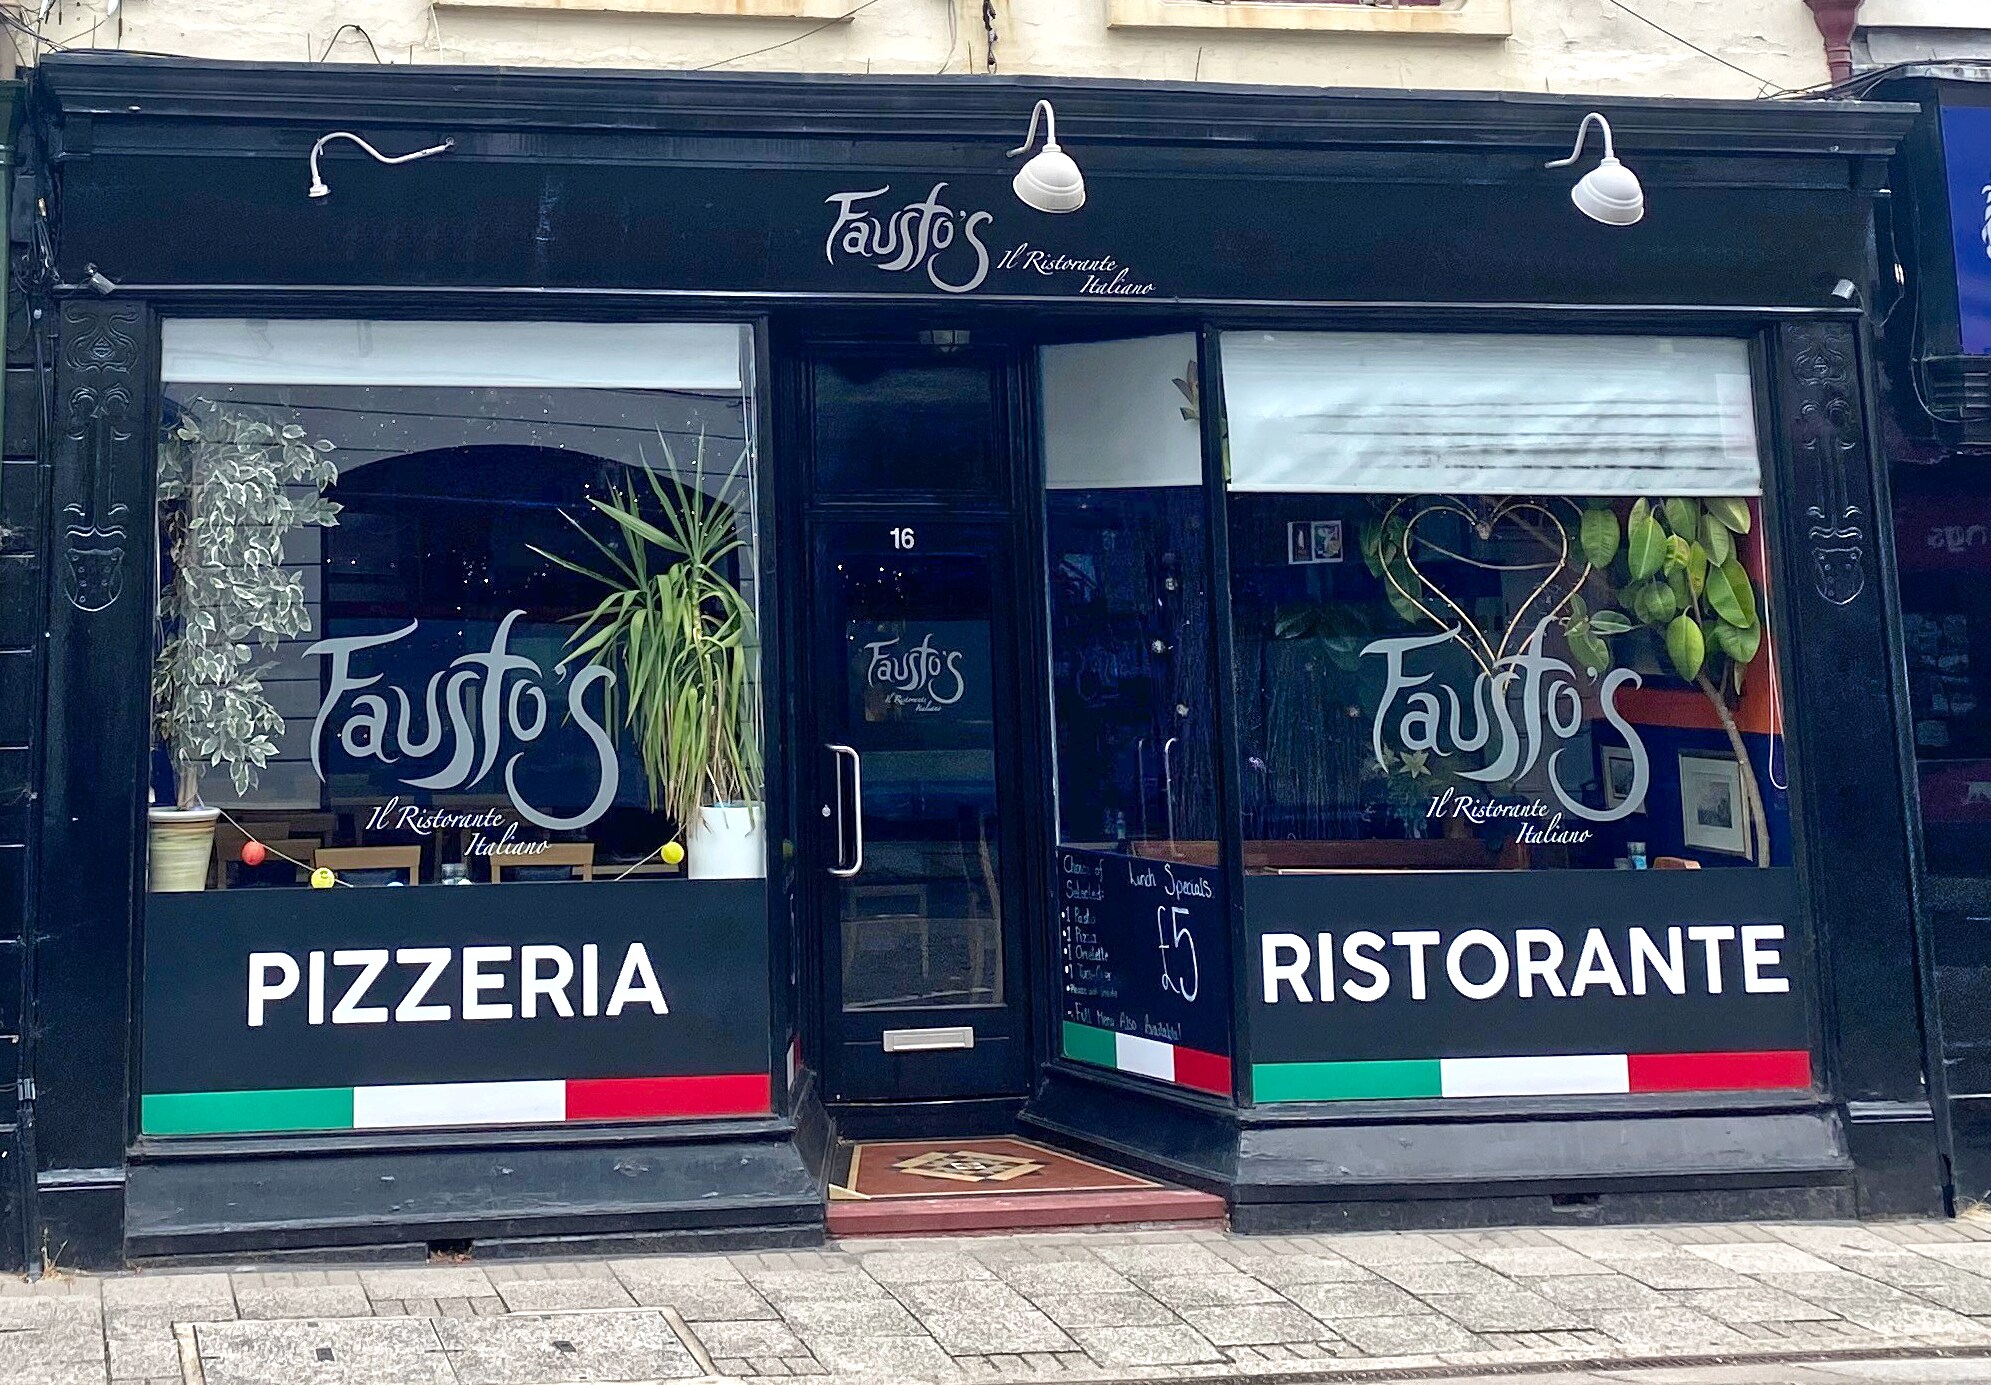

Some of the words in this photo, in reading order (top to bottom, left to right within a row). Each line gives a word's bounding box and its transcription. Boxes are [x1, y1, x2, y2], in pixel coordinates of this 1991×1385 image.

[825, 182, 993, 293] Fausto's
[997, 243, 1026, 269] Il
[1025, 250, 1118, 275] Ristorante
[1079, 267, 1156, 295] Italiano
[890, 527, 915, 549] 16
[864, 633, 964, 704] Fausto's
[301, 609, 619, 830] Fausto's
[1360, 614, 1649, 821] Fausto's
[365, 796, 399, 830] Il
[396, 805, 505, 835] Ristorante
[1426, 787, 1454, 817] Il
[1453, 796, 1550, 824] Ristorante
[464, 821, 552, 856] Italiano
[1515, 812, 1593, 844] Italiano
[1128, 861, 1156, 887] Lunch
[1164, 862, 1212, 900] Specials
[1157, 905, 1199, 1002] £5
[1261, 925, 1790, 1003] RISTORANTE
[248, 942, 669, 1026] PIZZERIA
